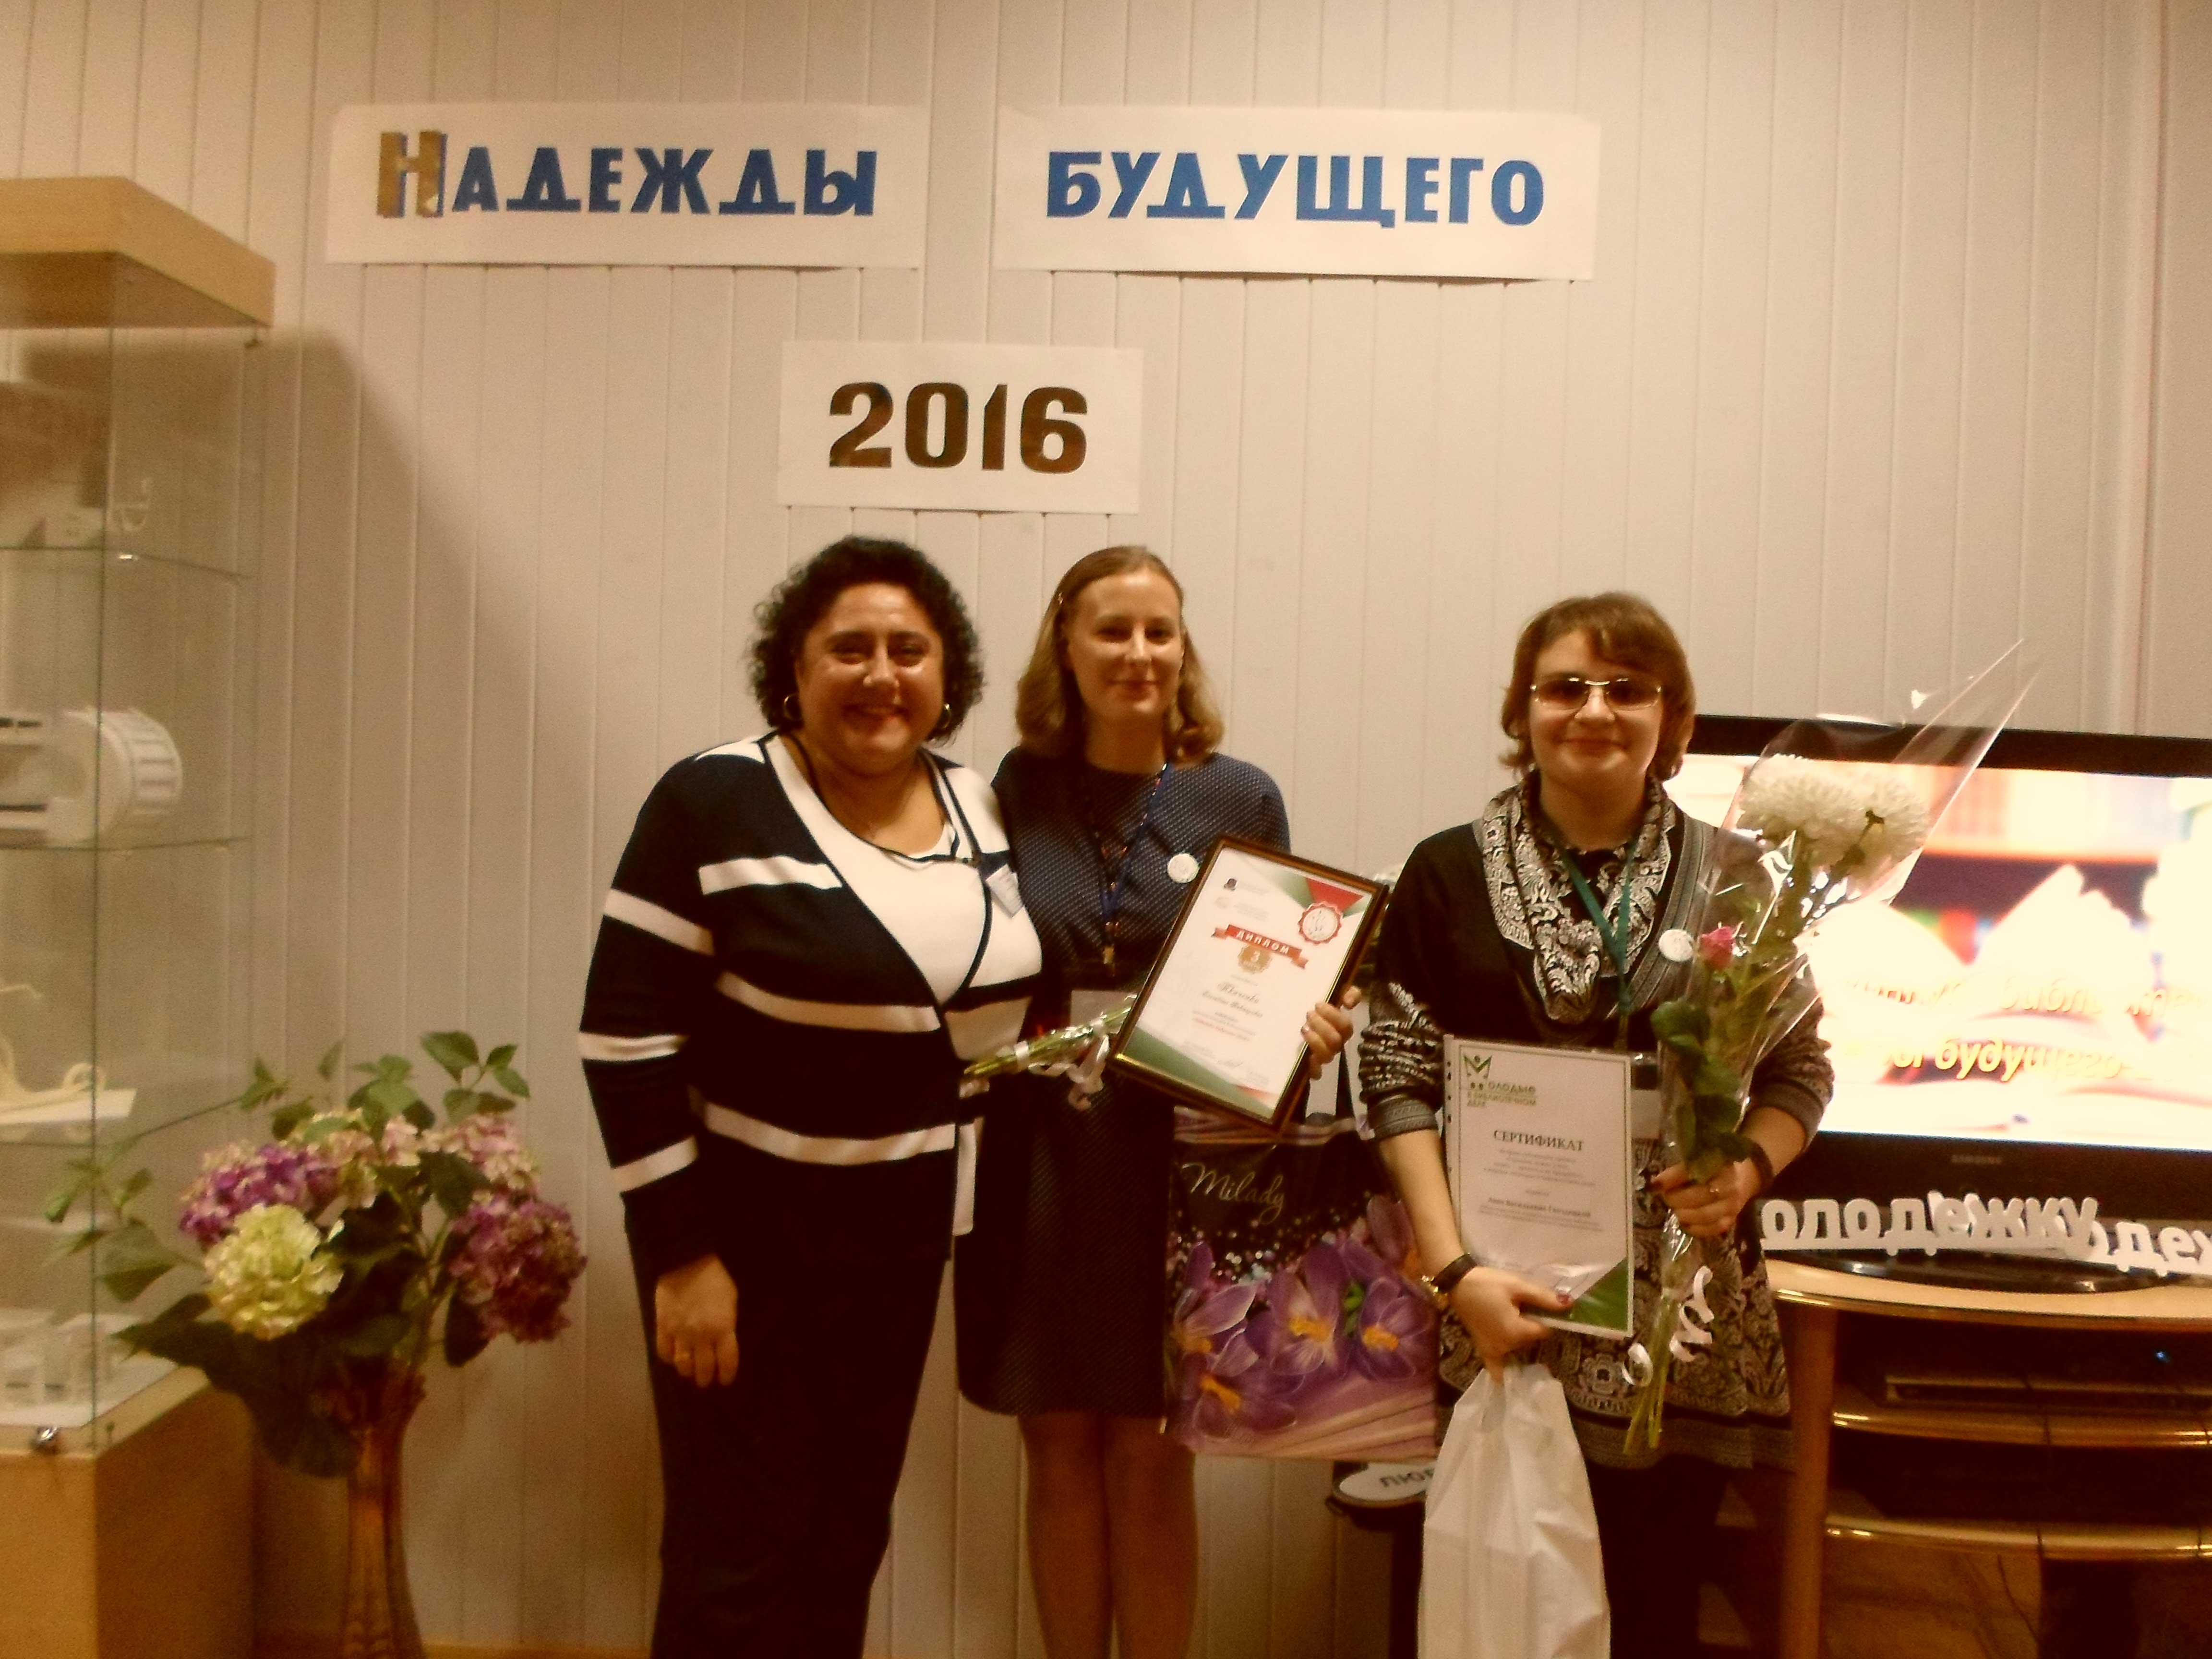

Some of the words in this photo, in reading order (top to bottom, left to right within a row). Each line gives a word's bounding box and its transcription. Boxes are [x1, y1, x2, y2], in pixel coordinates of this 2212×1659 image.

[376, 130, 878, 218] НАДЕЖДЫ
[1046, 151, 1544, 228] БУДУЩЕГО
[829, 382, 1087, 474] 2016
[1236, 929, 1289, 954] ДИПЛОМ
[1493, 1130, 1584, 1152] СЕРТИФИКАТ
[1181, 1162, 1286, 1225] Milady
[1760, 1197, 2098, 1262] олодежку
